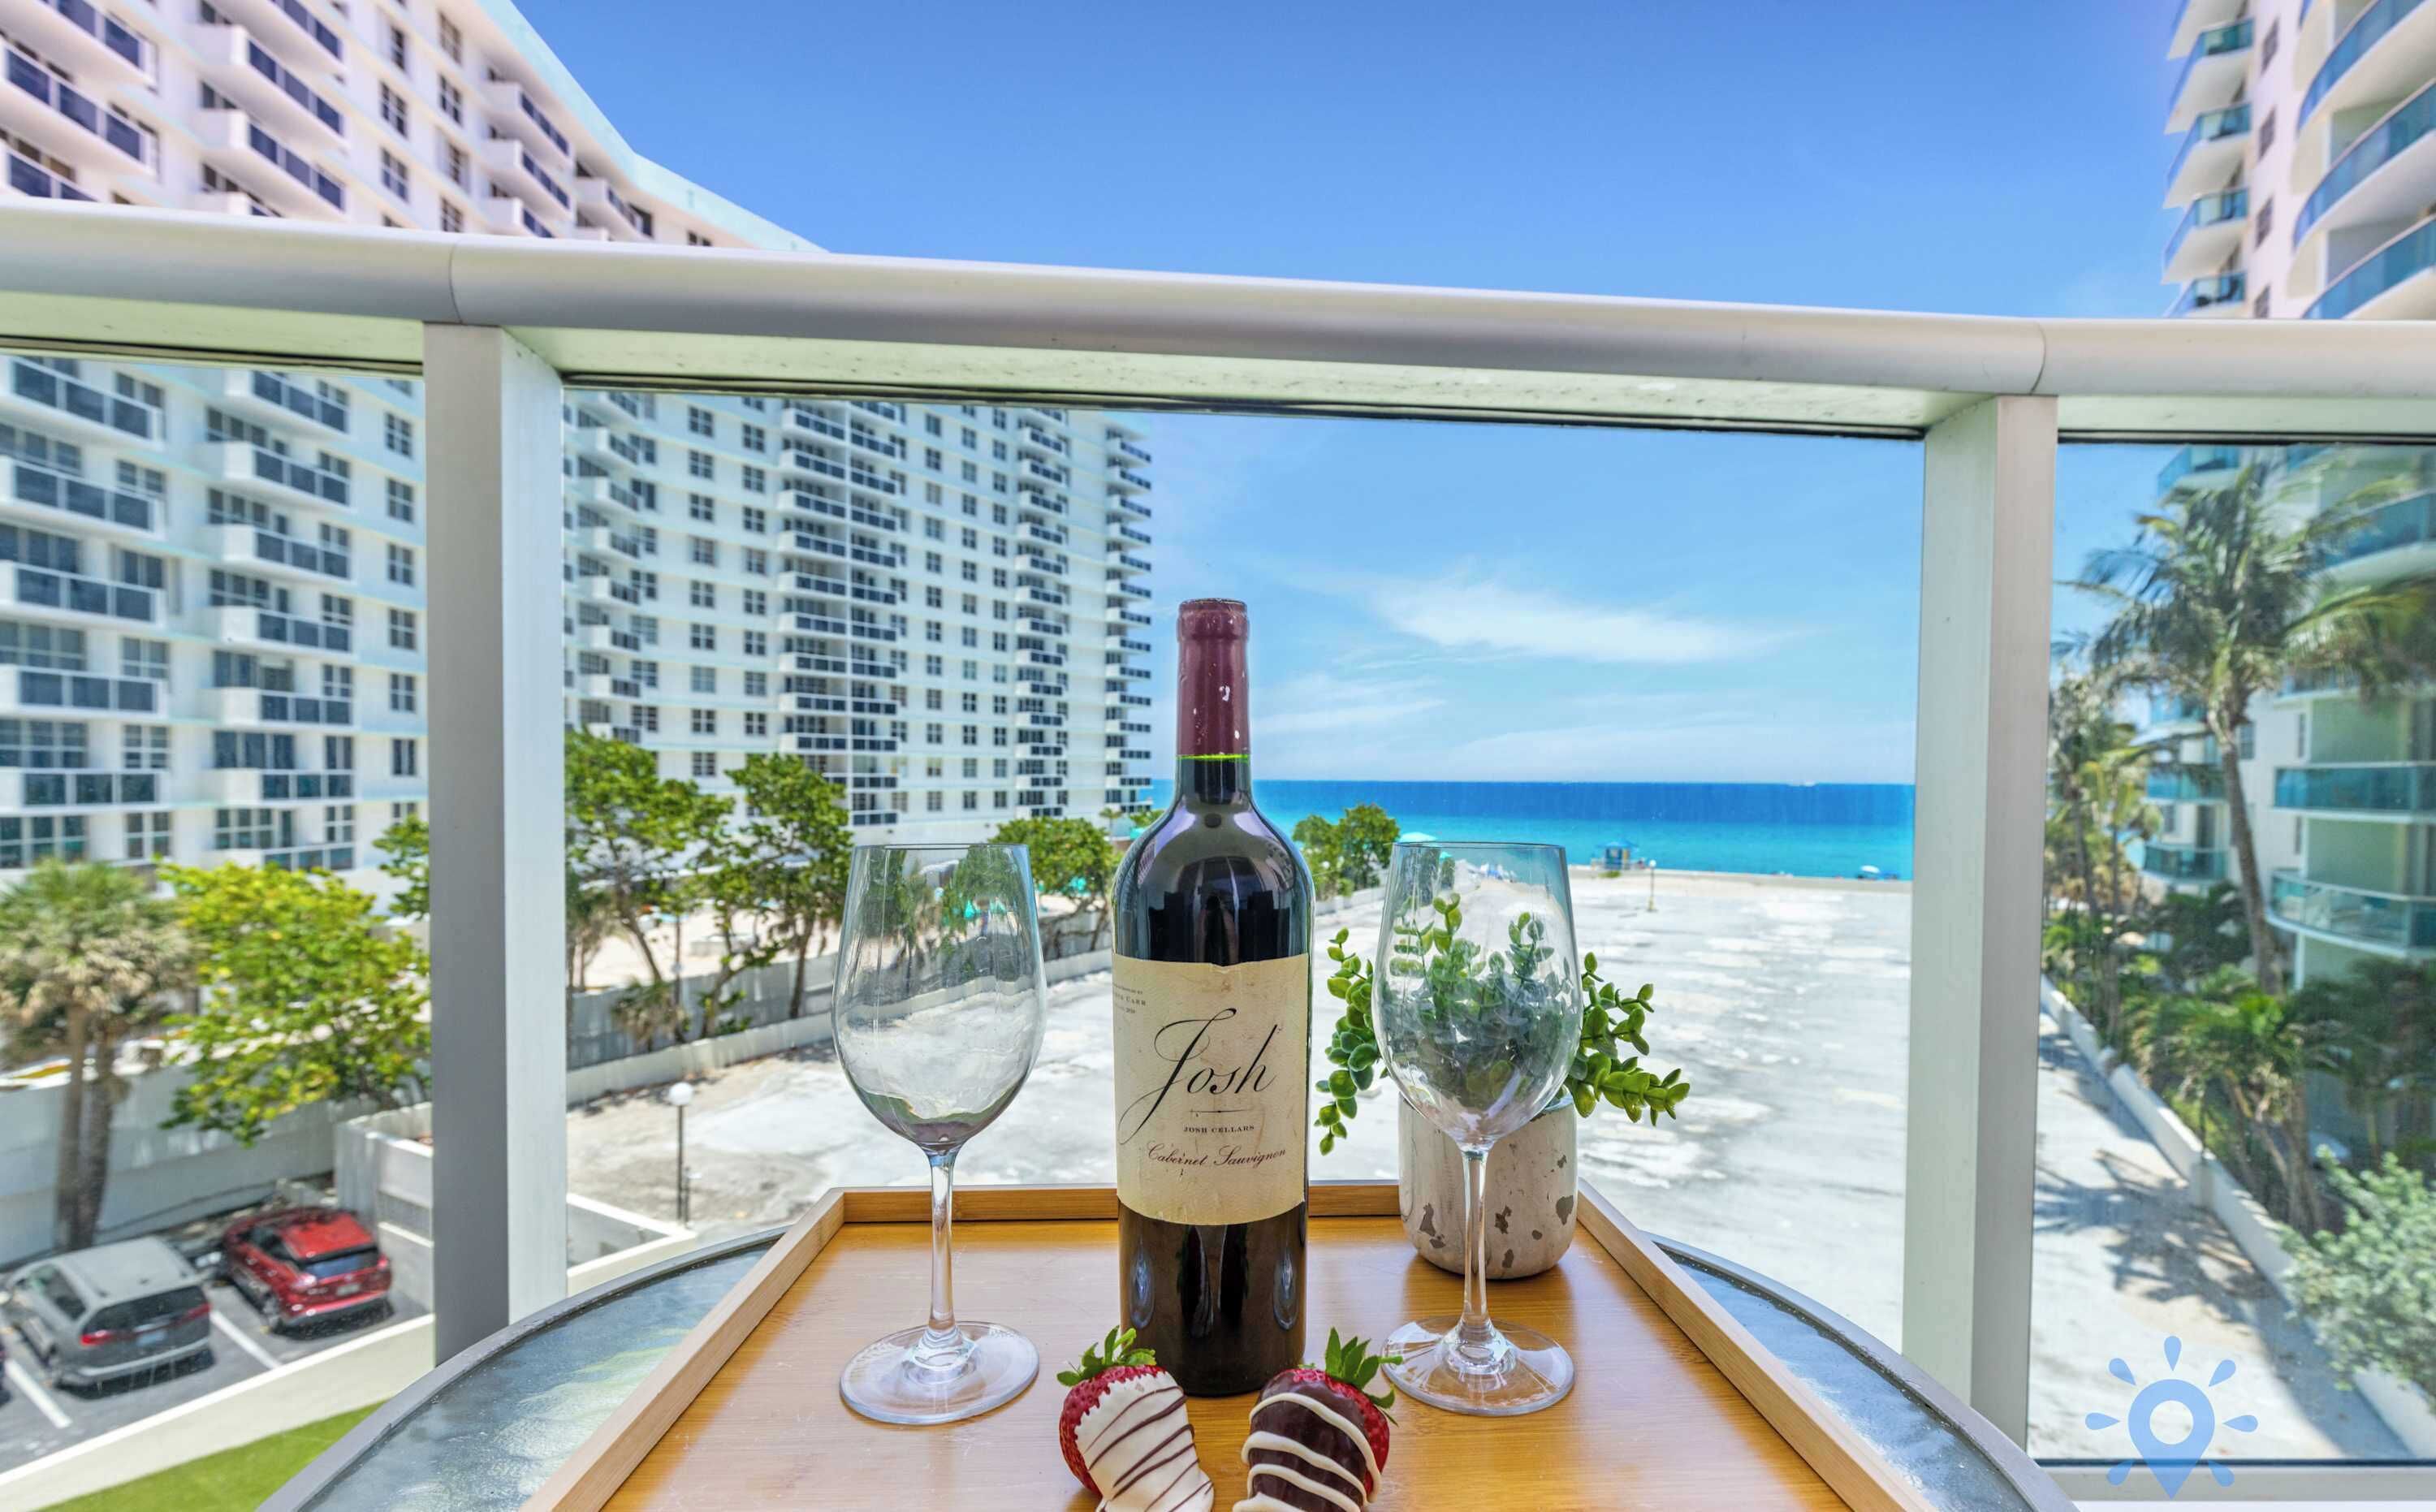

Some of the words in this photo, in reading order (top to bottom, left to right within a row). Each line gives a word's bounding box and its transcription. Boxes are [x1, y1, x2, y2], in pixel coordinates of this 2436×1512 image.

[1118, 1008, 1277, 1145] Josh
[1183, 1125, 1208, 1134] JOSH
[1212, 1125, 1255, 1134] CELLARS
[1147, 1142, 1208, 1166] Cabernet
[1213, 1144, 1286, 1168] Sauvignon
